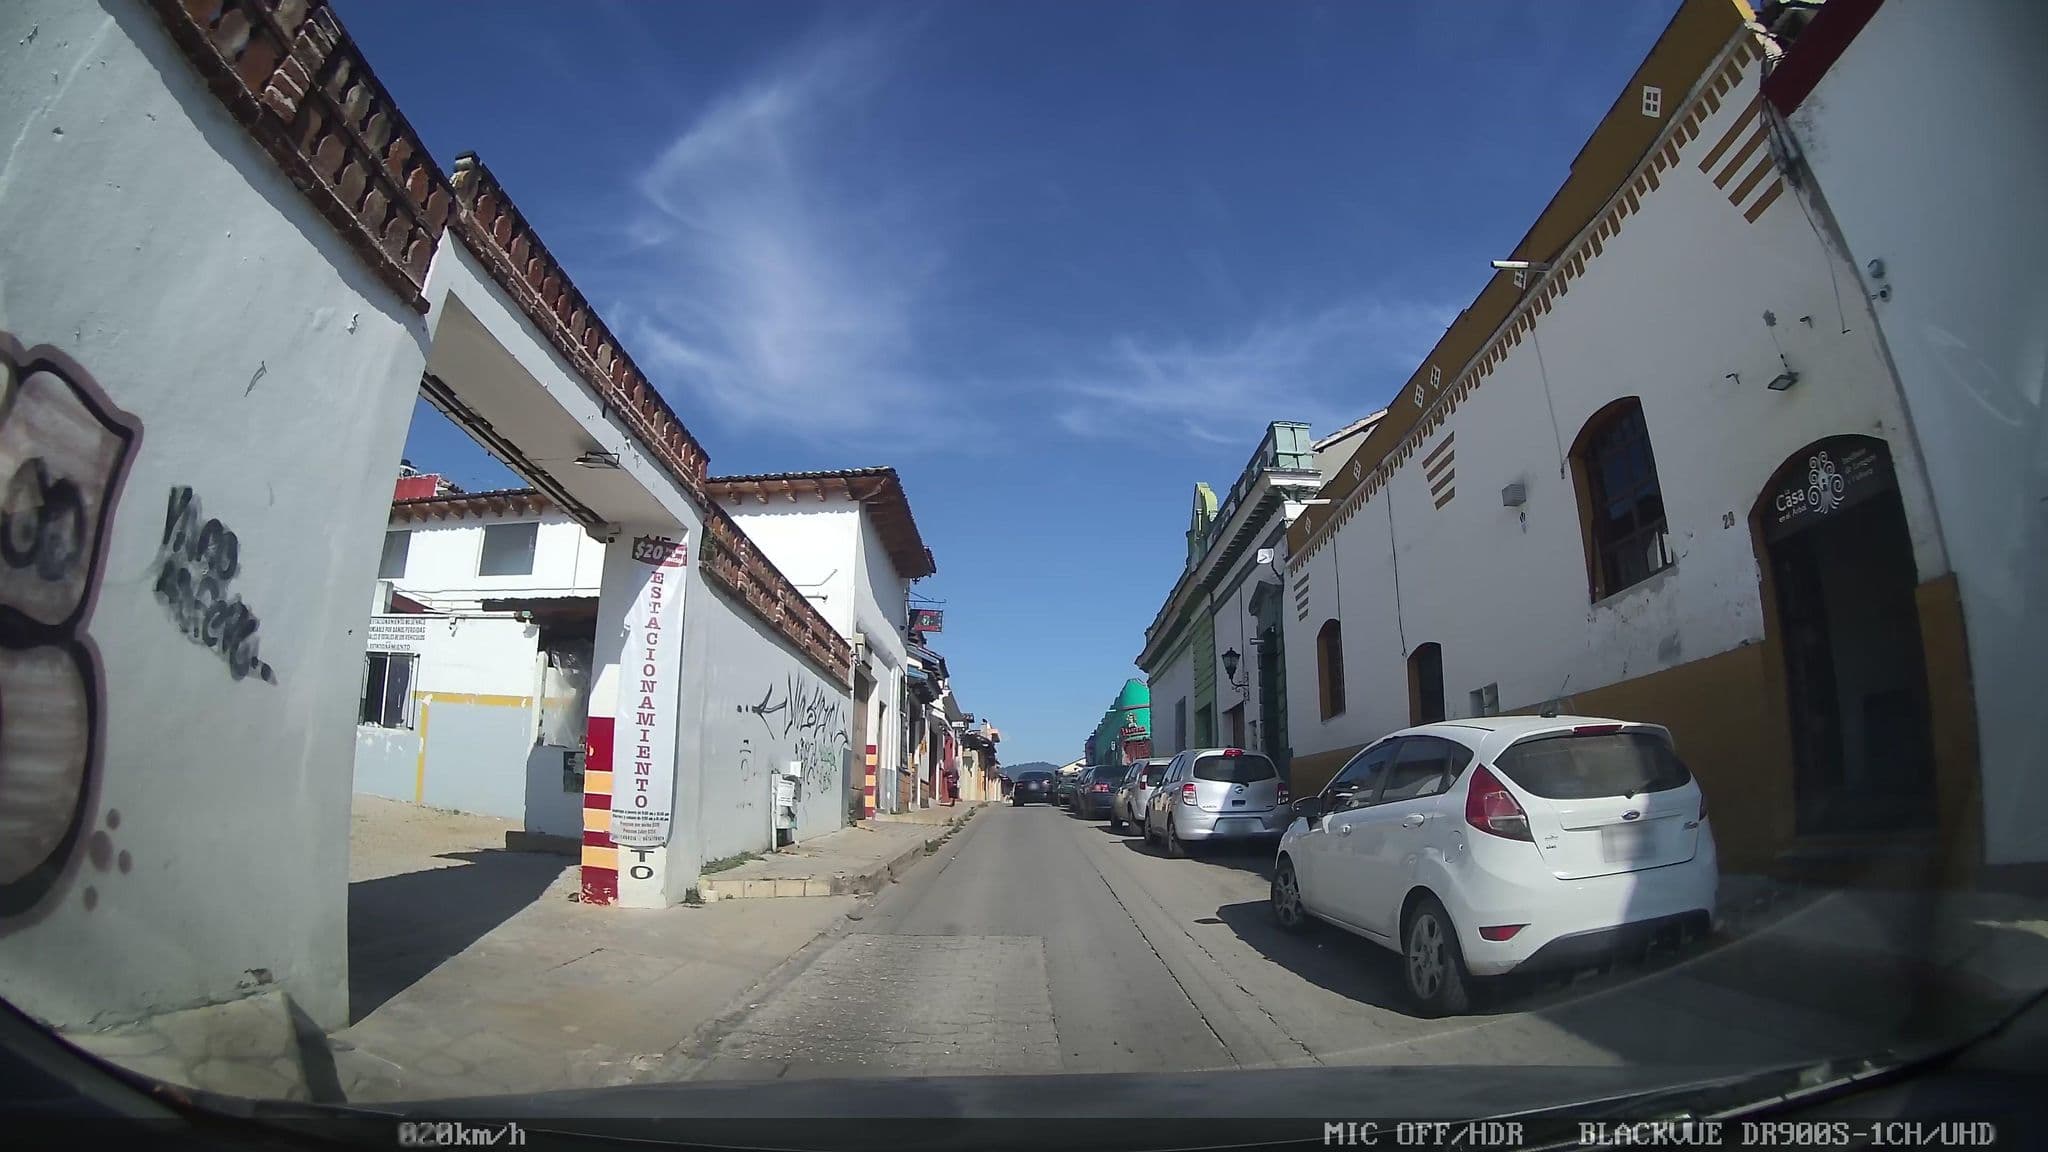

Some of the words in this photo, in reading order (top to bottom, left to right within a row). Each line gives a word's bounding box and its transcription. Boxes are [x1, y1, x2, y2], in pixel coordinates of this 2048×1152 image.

[1776, 489, 1805, 511] Casa
[634, 541, 664, 561] $20
[634, 571, 665, 809] ESTACIONAMIENTO
